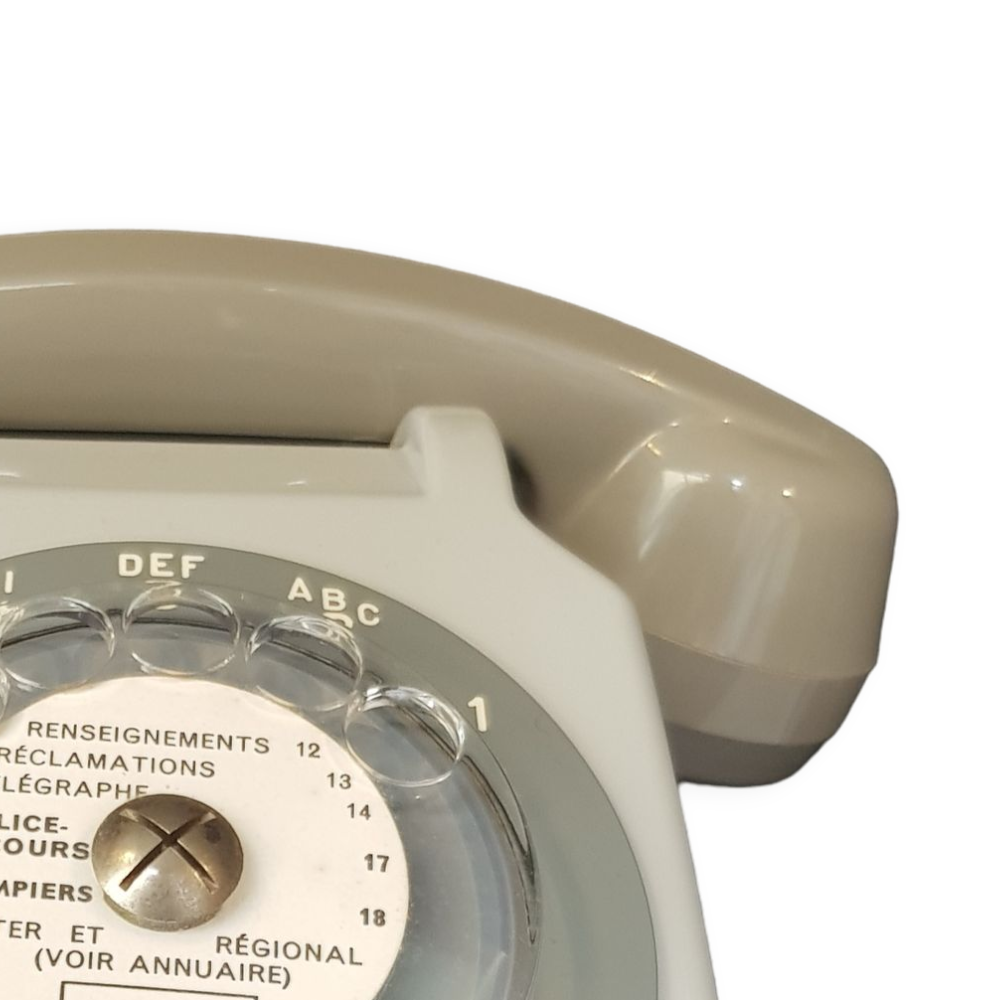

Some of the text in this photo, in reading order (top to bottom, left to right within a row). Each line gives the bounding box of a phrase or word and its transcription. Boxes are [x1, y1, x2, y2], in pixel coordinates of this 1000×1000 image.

[118, 552, 205, 578] DEF
[287, 577, 380, 627] ABC
[467, 696, 489, 732] 1
[27, 721, 321, 758] RENSEIGNEMENTS 12
[326, 773, 352, 790] 13
[347, 803, 372, 821] 14
[364, 853, 390, 873] 17
[359, 908, 387, 927] 18
[70, 925, 104, 945] ET
[215, 936, 363, 966] RÉGIONAL
[34, 948, 292, 989] (VOIR ANNUAIRE)
